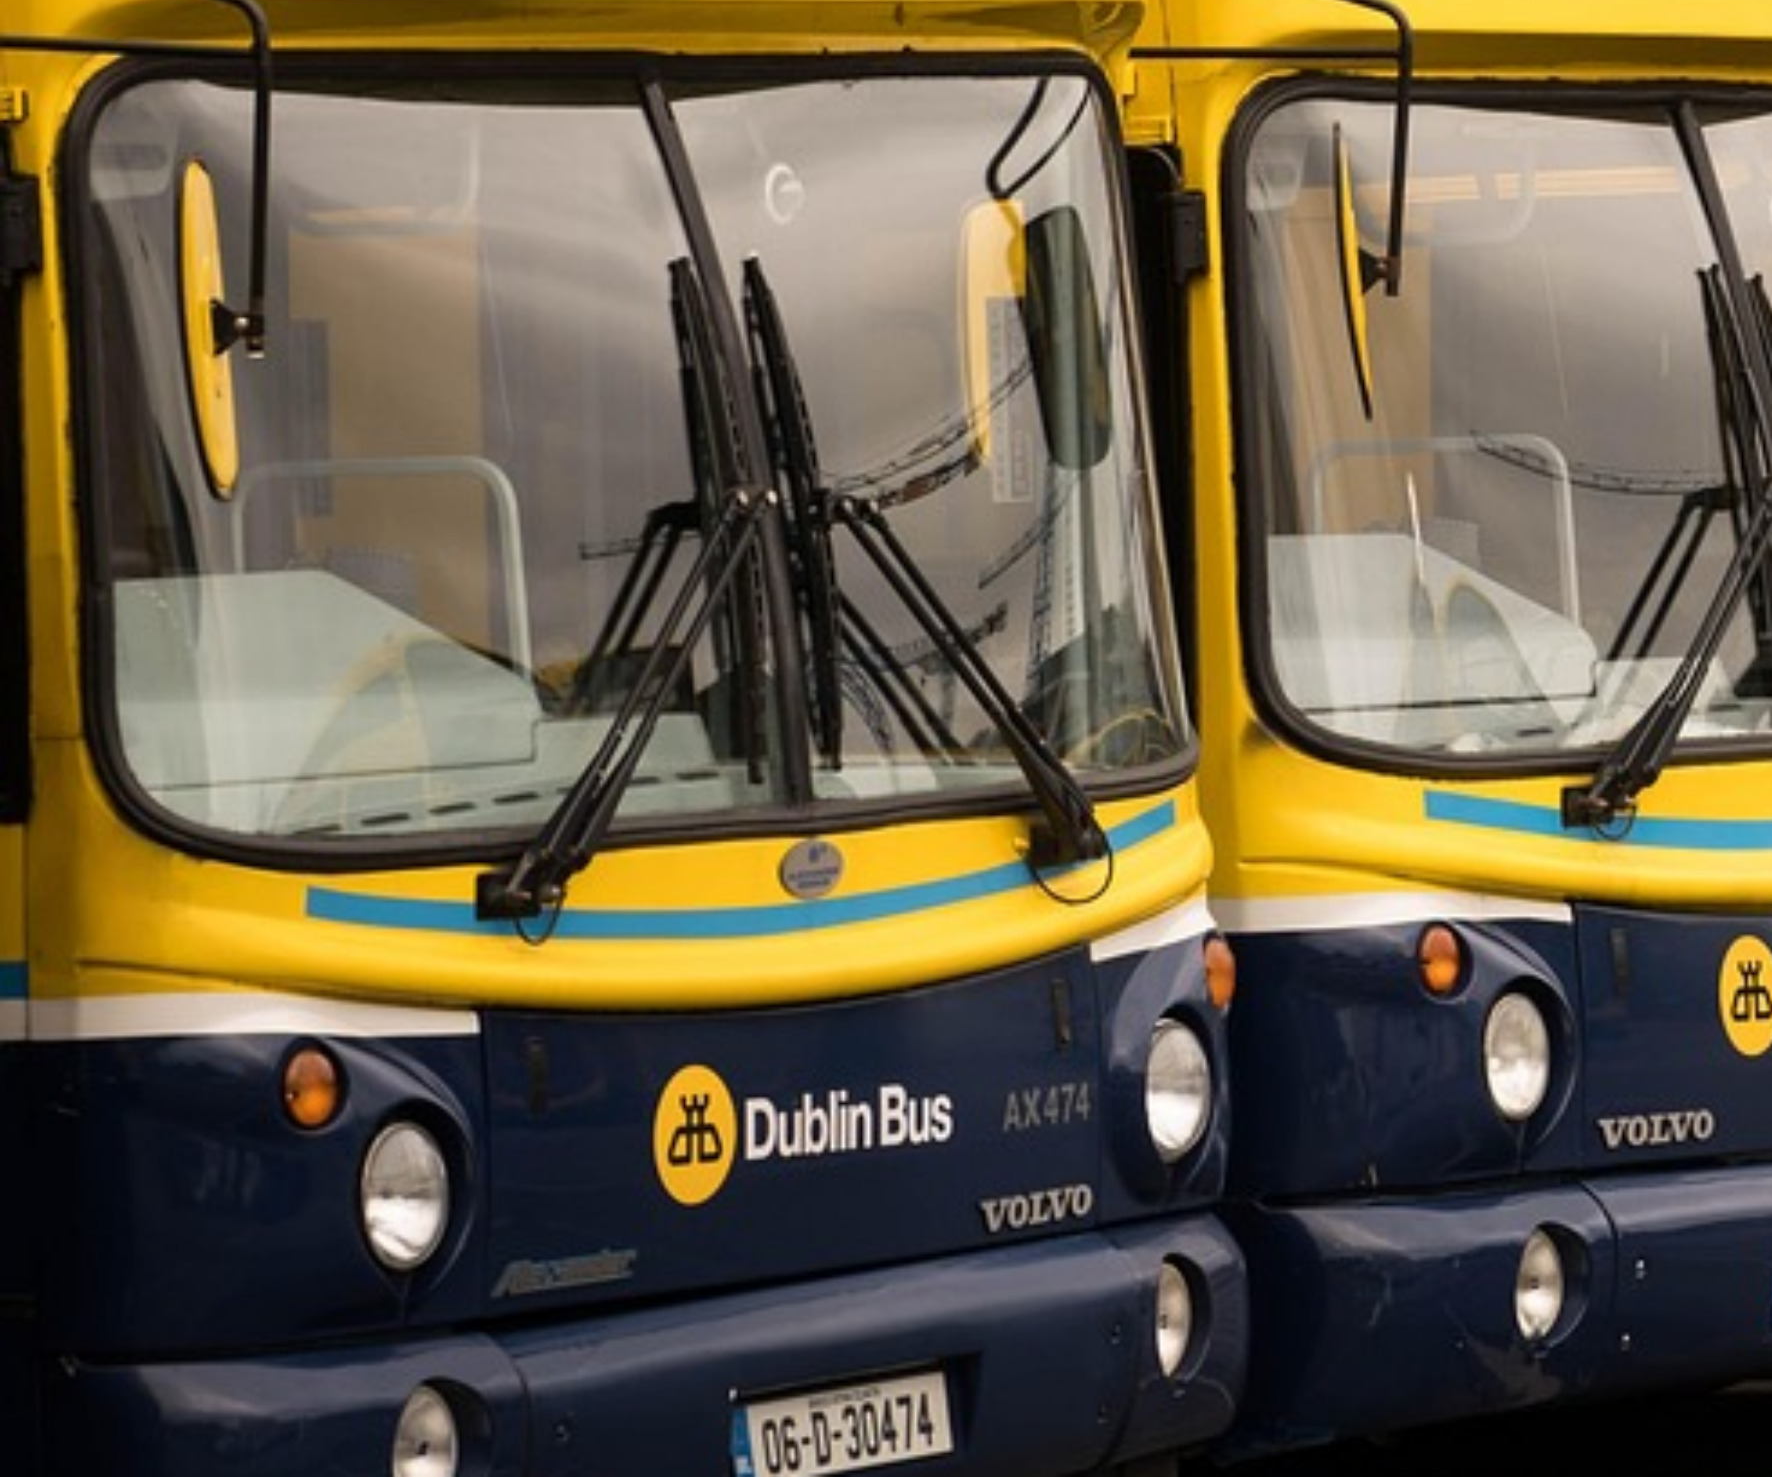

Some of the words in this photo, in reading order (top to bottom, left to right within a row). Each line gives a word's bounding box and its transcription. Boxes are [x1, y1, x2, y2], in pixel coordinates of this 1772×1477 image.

[744, 1088, 873, 1161] Dublin
[878, 1084, 955, 1147] Bus
[1597, 1107, 1716, 1151] VOLVO
[981, 1183, 1093, 1233] VOLVO
[761, 1391, 934, 1475] 06-D-30474
